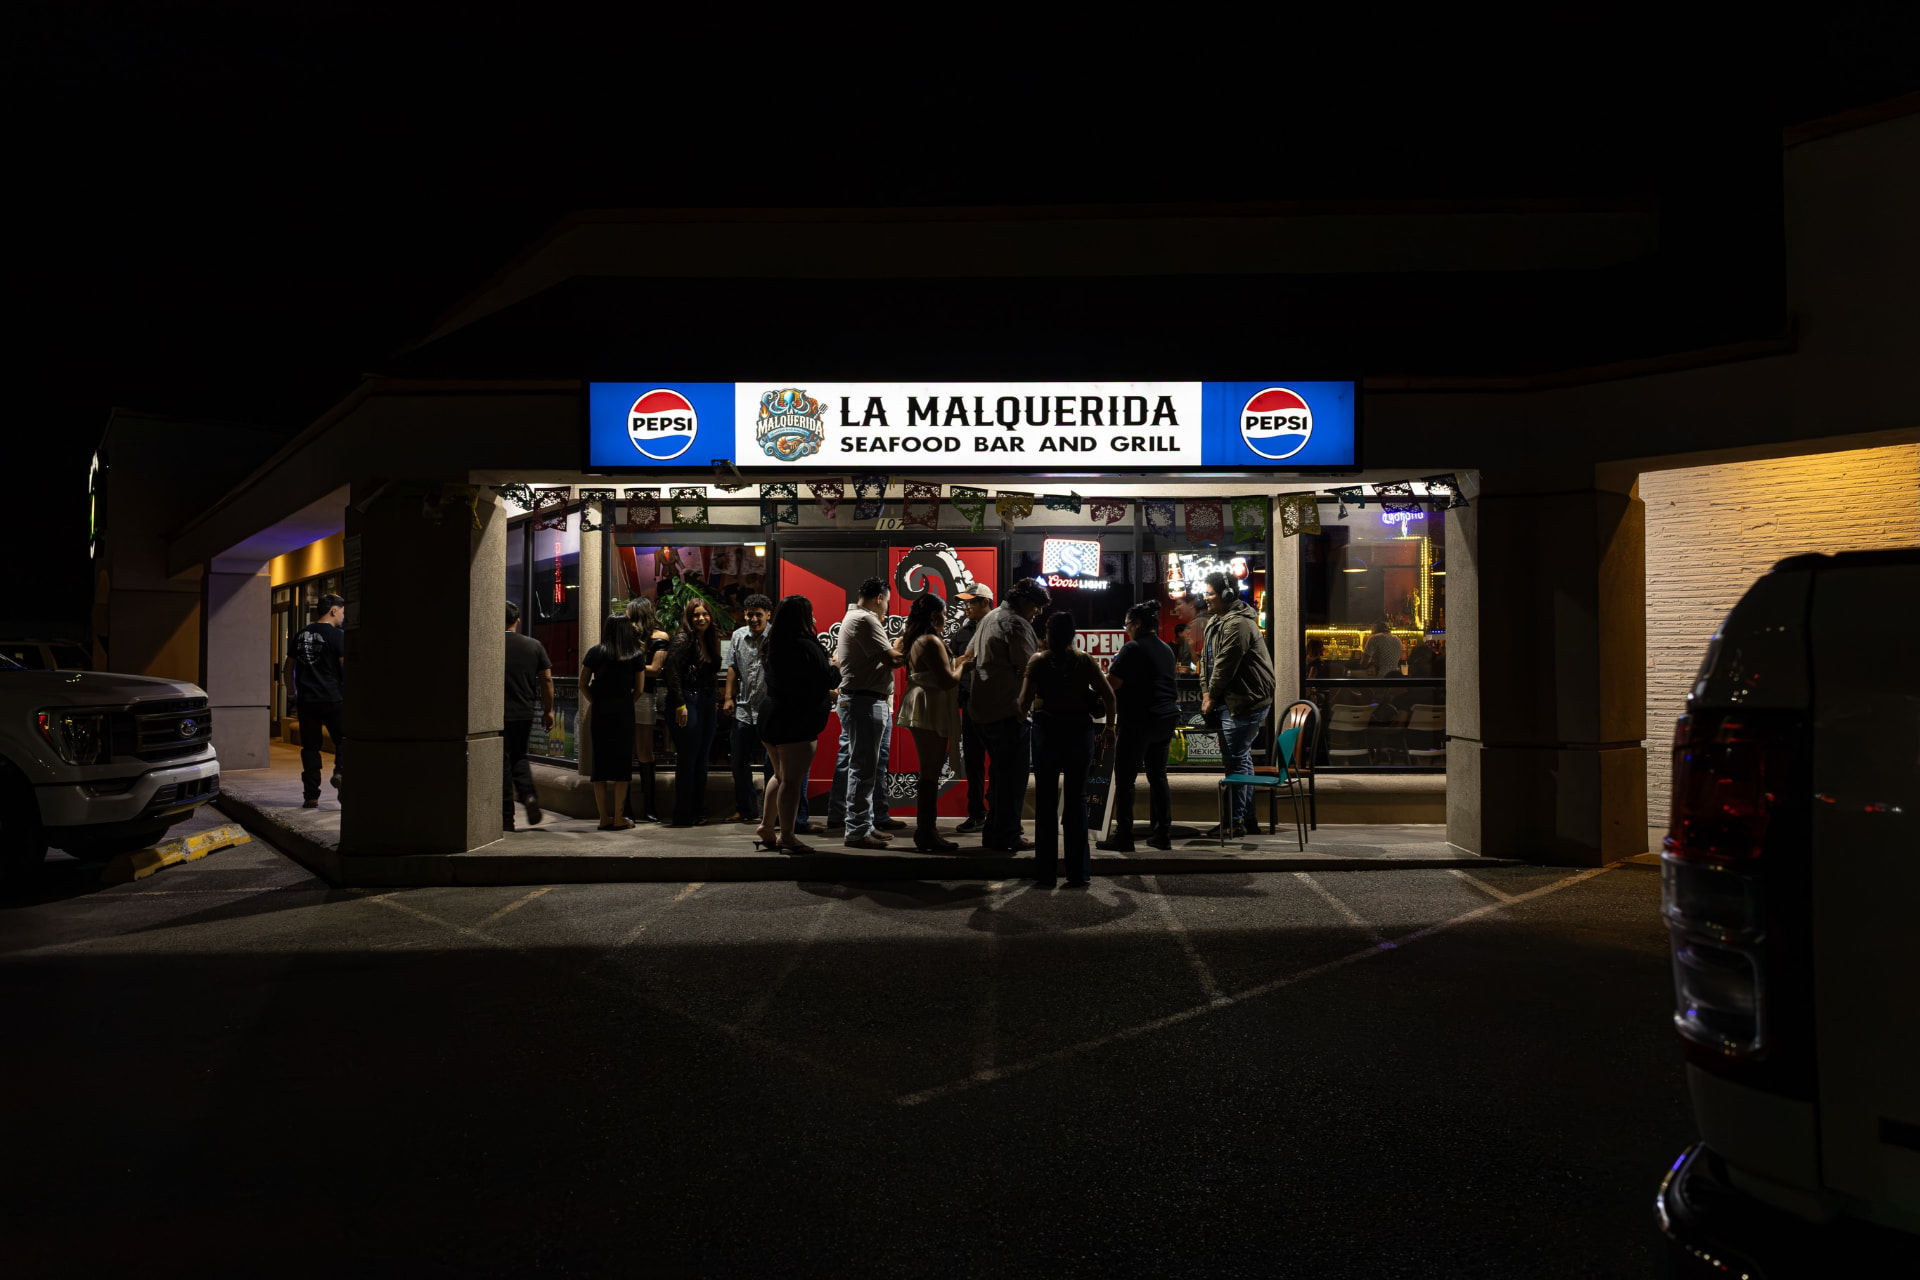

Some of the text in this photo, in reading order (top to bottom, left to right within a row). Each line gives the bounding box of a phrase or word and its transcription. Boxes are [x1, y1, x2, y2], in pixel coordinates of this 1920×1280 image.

[840, 395, 1180, 431] LA MALQUERIDA
[633, 417, 692, 431] PEPSI
[757, 415, 824, 440] MALQUERIDA
[1246, 416, 1307, 430] PEPSI
[840, 435, 1180, 452] SEAFOOD BAR AND GRILL
[879, 518, 905, 530] 107
[1048, 575, 1108, 590] Coors LIGHT
[1072, 633, 1125, 654] OPEN
